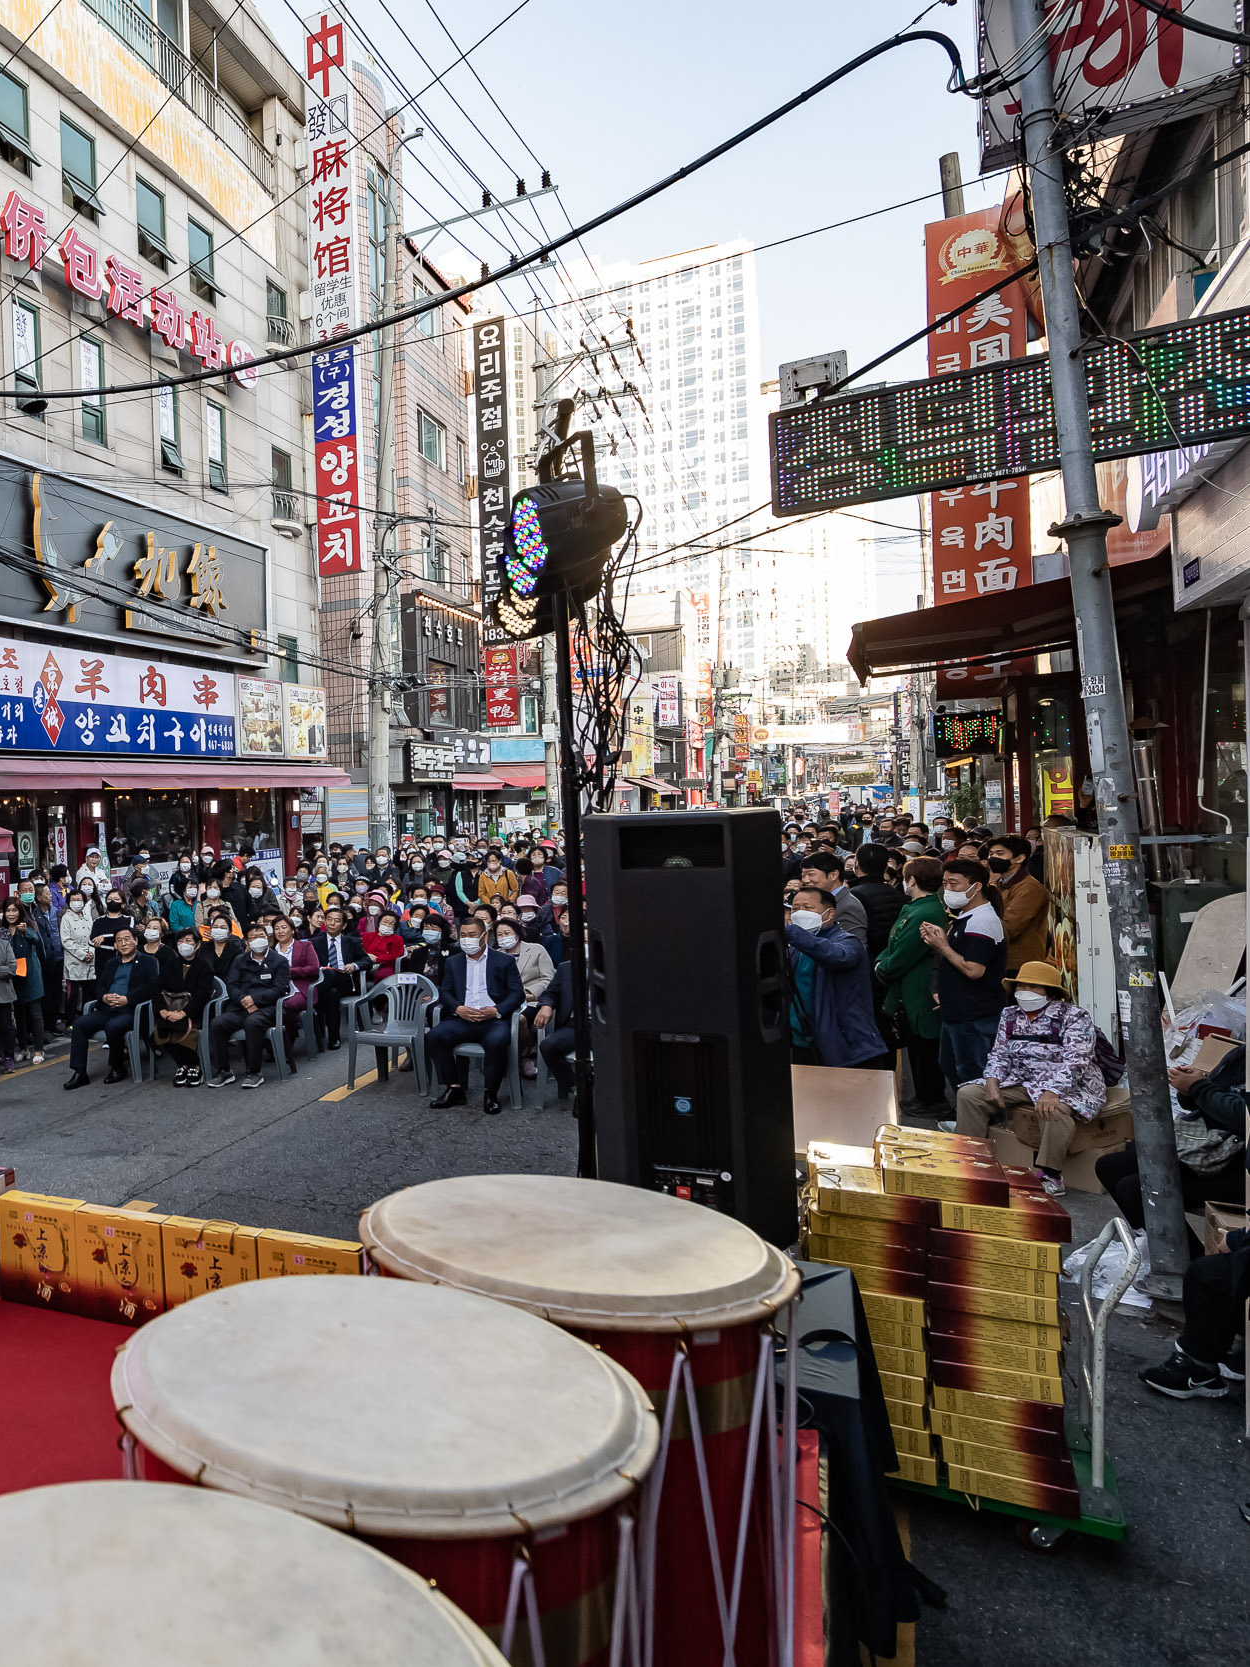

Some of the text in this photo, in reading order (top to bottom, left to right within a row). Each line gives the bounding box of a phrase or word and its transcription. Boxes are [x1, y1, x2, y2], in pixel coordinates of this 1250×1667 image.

[310, 141, 351, 280] 麻将馆
[950, 260, 999, 276] China Restaurant
[957, 241, 989, 258] 中華
[0, 190, 223, 370] 侨包活动站
[314, 275, 352, 298] 留学生
[321, 292, 346, 311] 优惠
[314, 349, 350, 368] 원조
[320, 363, 350, 383] (구)
[478, 325, 502, 430] 요리주점
[316, 381, 352, 438] 경성
[318, 444, 354, 568] 양꼬치
[423, 615, 464, 647] 천수호프
[75, 658, 219, 711] 羊肉串
[75, 707, 207, 752] 양꼬치구이
